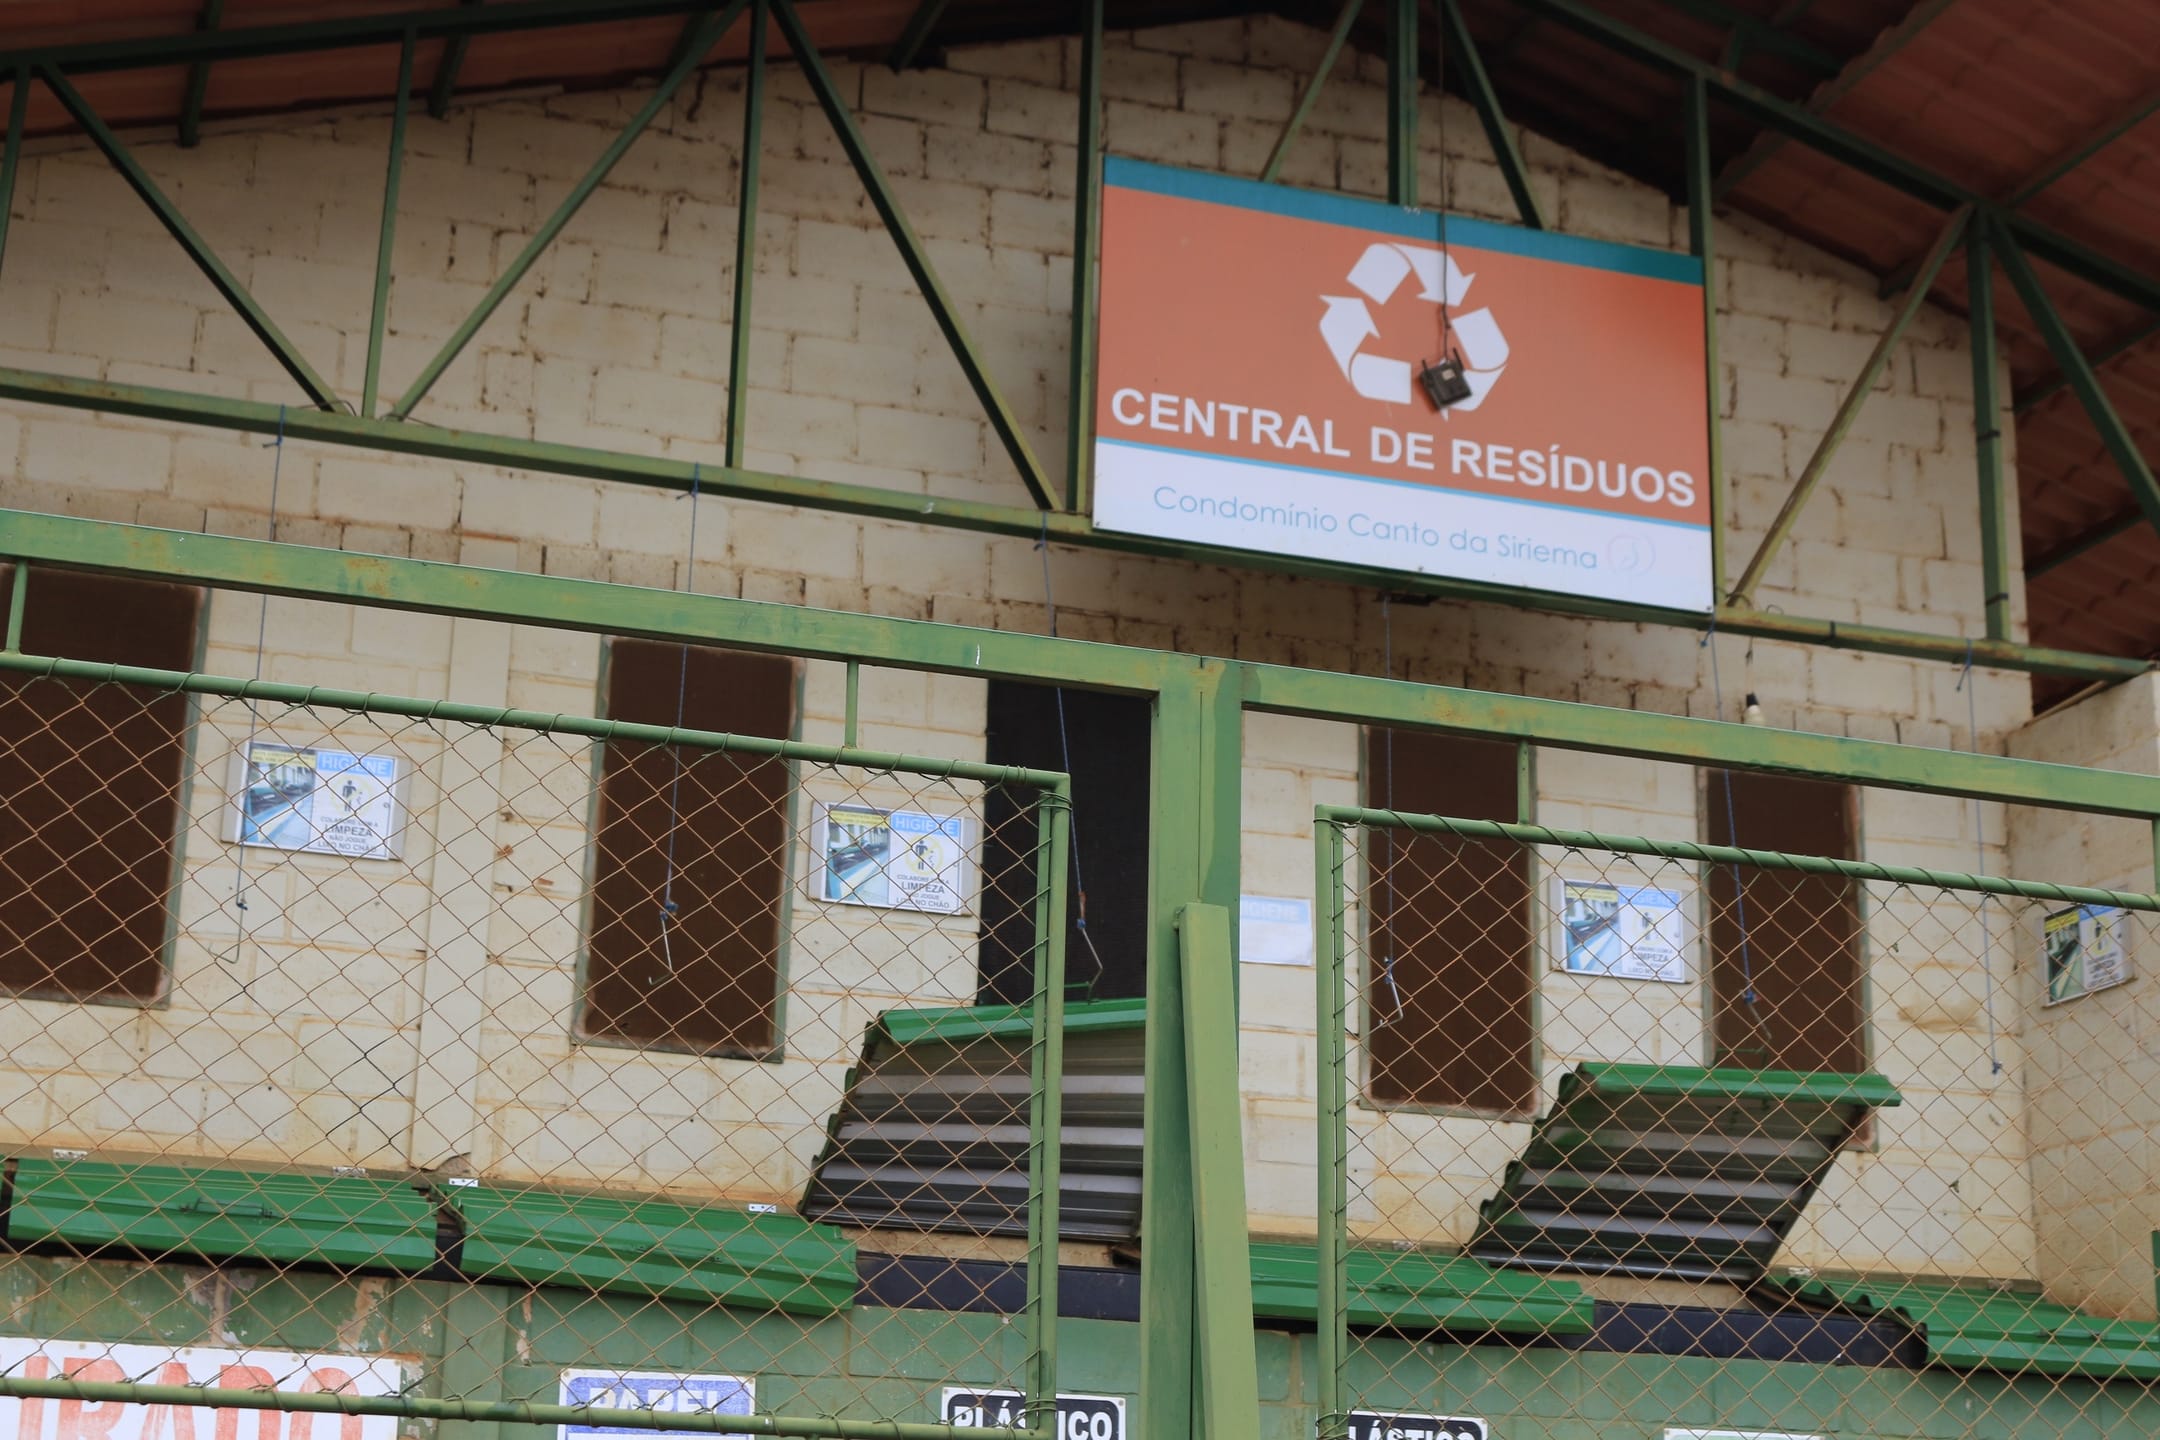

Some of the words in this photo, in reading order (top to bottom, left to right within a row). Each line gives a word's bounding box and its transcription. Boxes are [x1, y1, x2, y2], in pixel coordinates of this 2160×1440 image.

[1111, 388, 1350, 458] CENTRAL
[1370, 427, 1434, 470] DE
[1452, 438, 1696, 507] RESÍDUOS
[1153, 485, 1338, 534] Condomínio
[1348, 511, 1440, 547] Canto
[1449, 528, 1488, 554] da
[1497, 533, 1598, 570] Siriema
[896, 816, 955, 836] HIGIEE
